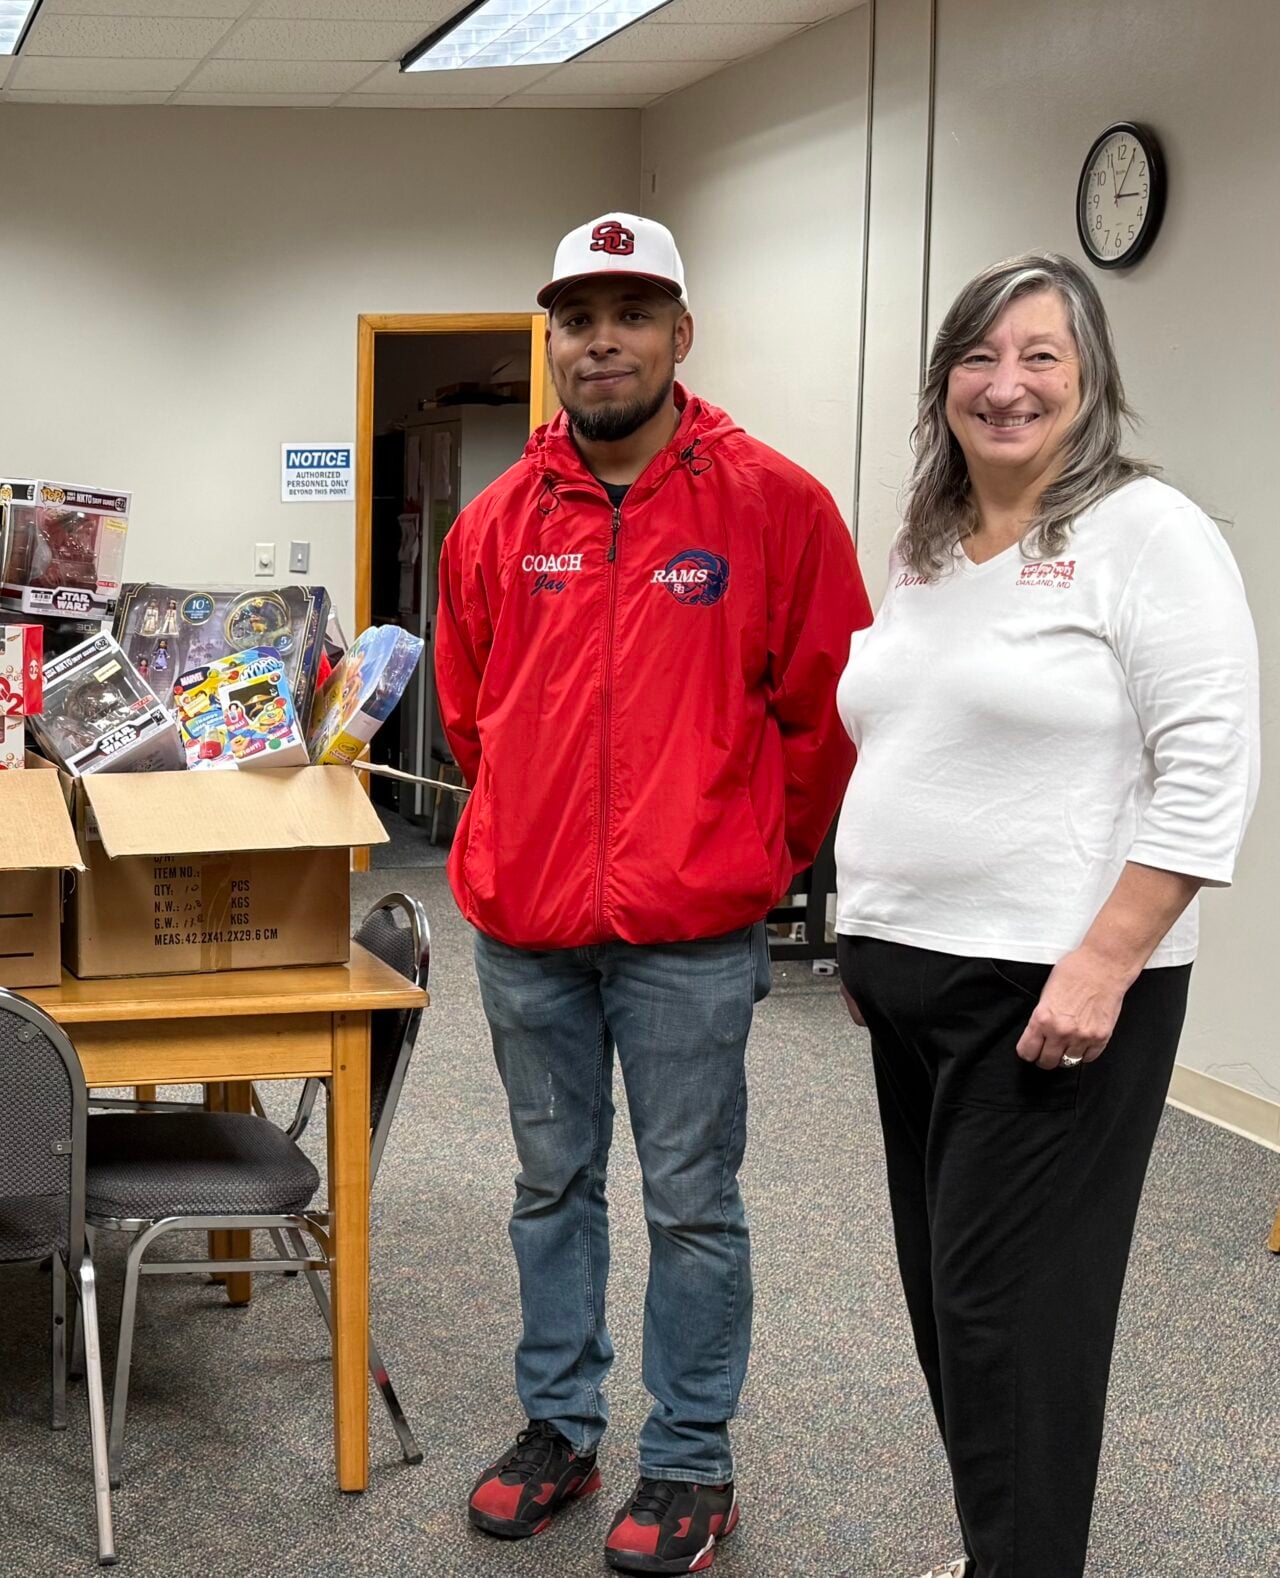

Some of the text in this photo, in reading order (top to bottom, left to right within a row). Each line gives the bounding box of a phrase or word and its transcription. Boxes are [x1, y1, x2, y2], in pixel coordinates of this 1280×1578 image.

[1117, 144, 1127, 161] 12
[1139, 161, 1145, 177] 2
[1097, 171, 1107, 186] 10
[1141, 183, 1148, 199] 3
[1093, 195, 1100, 209] 9
[1137, 206, 1143, 221] 4
[1096, 215, 1103, 230] 8
[1104, 230, 1110, 246] 7
[1115, 232, 1122, 248] 6
[1128, 225, 1135, 240] 5
[288, 452, 348, 466] NOTICE
[522, 553, 583, 572] COACH
[650, 569, 708, 584] RAMS
[530, 574, 568, 596] Jay
[57, 592, 90, 603] STAR
[57, 600, 90, 612] WARS
[180, 671, 204, 687] MARVEL
[99, 725, 135, 750] STAR
[101, 732, 137, 755] WARS
[153, 866, 200, 880] ITEM NO.:
[154, 884, 174, 897] QTY:
[231, 880, 250, 892] PCS
[154, 901, 180, 913] N.W.:
[231, 896, 250, 909] KGS
[154, 917, 179, 930] G.W.:
[230, 913, 249, 925] KGS
[263, 928, 278, 940] CM
